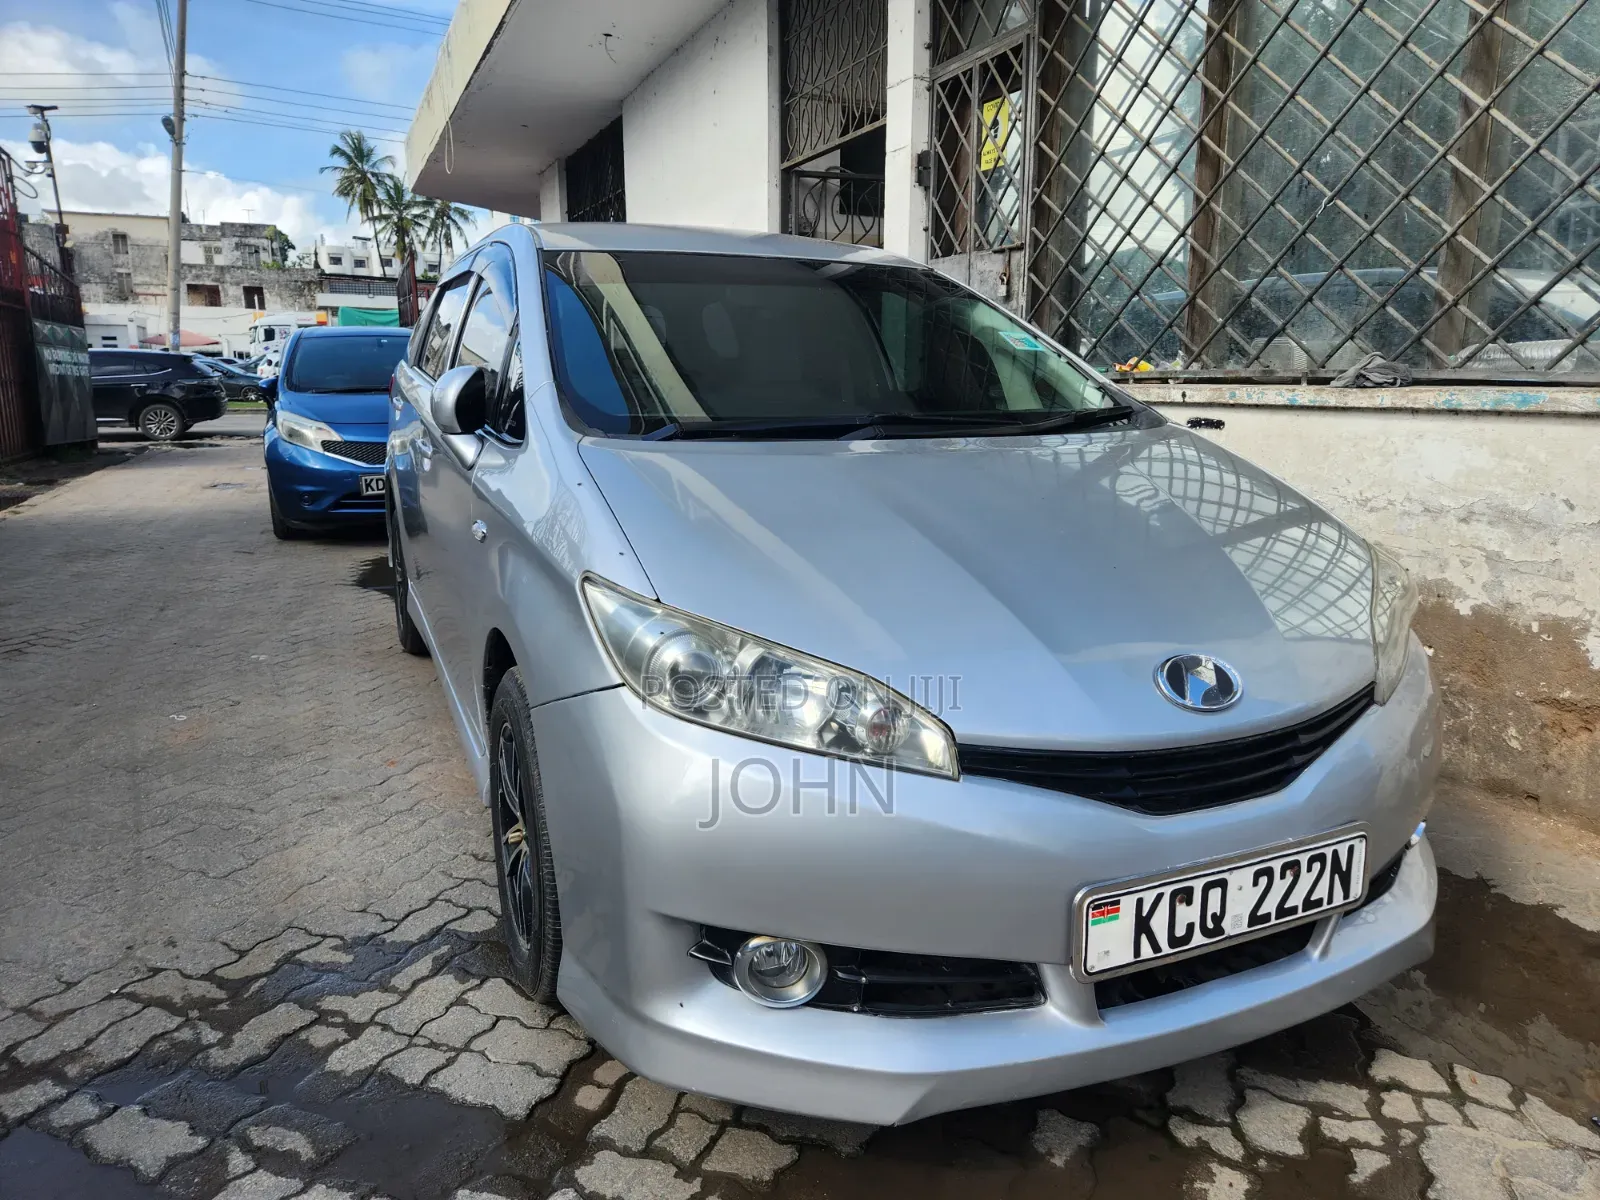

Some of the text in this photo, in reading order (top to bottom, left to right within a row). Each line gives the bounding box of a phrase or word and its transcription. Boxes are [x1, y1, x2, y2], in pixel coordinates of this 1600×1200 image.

[364, 478, 385, 492] KD
[1133, 877, 1228, 958] KCQ
[1247, 844, 1355, 928] 222N
